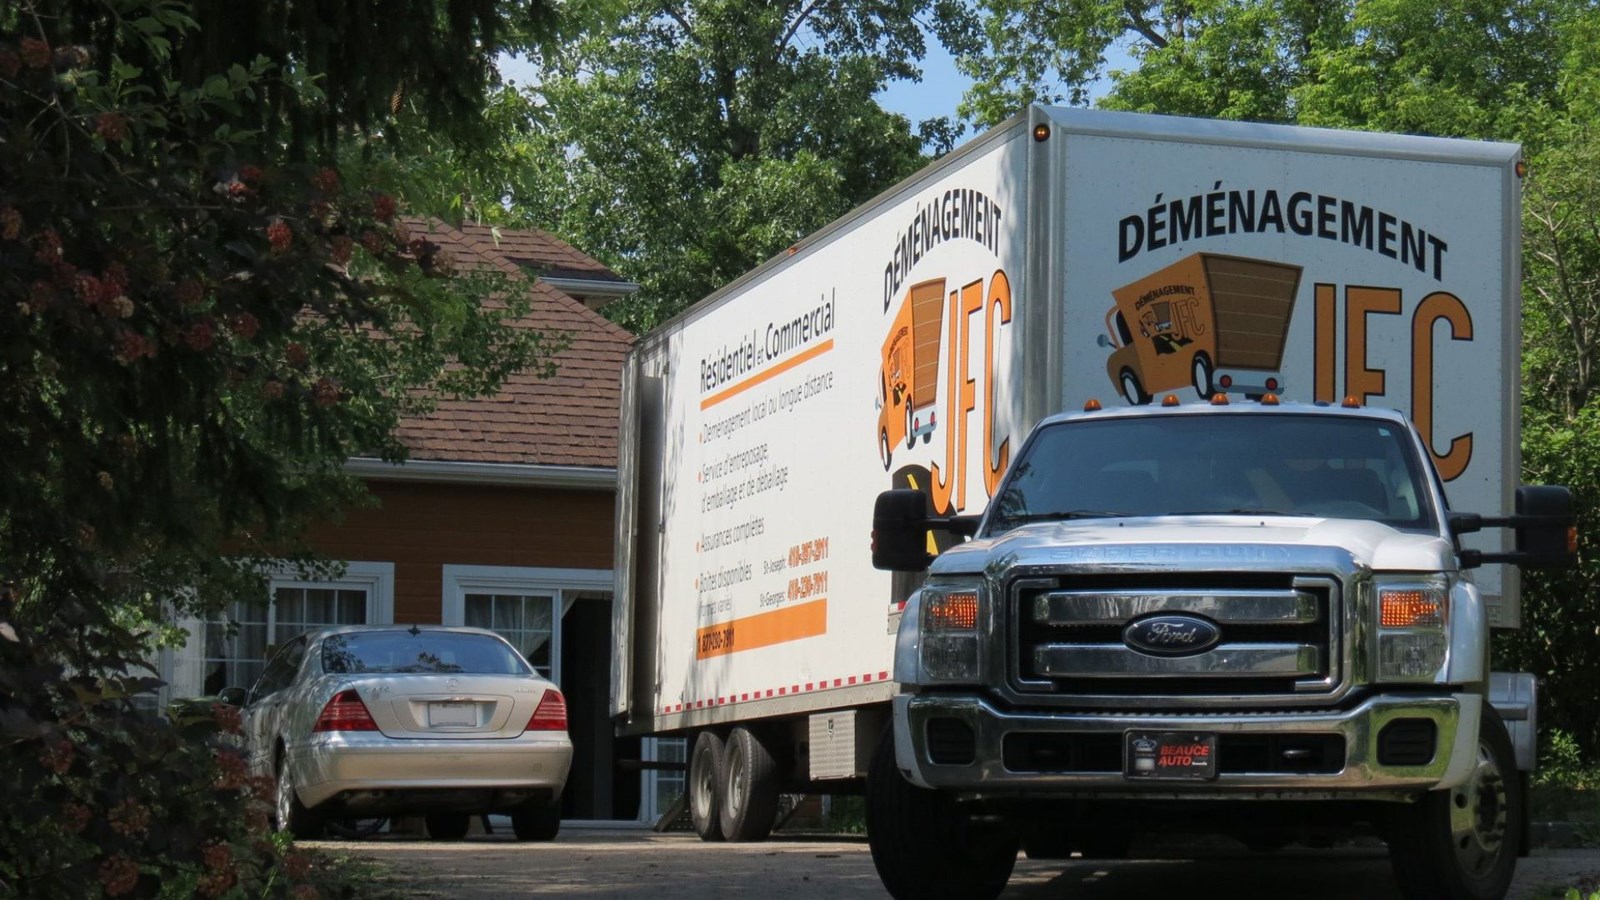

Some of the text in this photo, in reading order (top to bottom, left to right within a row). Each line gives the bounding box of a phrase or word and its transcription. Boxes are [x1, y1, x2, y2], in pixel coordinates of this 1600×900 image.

[1118, 180, 1447, 282] DÉMÉNAGEMENT
[883, 188, 1001, 315] DÉMÉNAGEMENT
[1170, 297, 1205, 340] JFC
[700, 329, 756, 394] Résidentiel
[757, 346, 764, 365] et
[765, 286, 835, 361] Commercial
[703, 371, 833, 444] Déménagement local ou longue distance
[931, 268, 1012, 515] JFC
[702, 459, 722, 485] Service
[747, 473, 754, 497] de
[701, 515, 765, 552] Assurances complètes
[718, 558, 752, 592] disponibles
[1148, 621, 1197, 644] Ford
[1158, 756, 1192, 766] AUTO
[1161, 745, 1209, 756] BEAUCE
